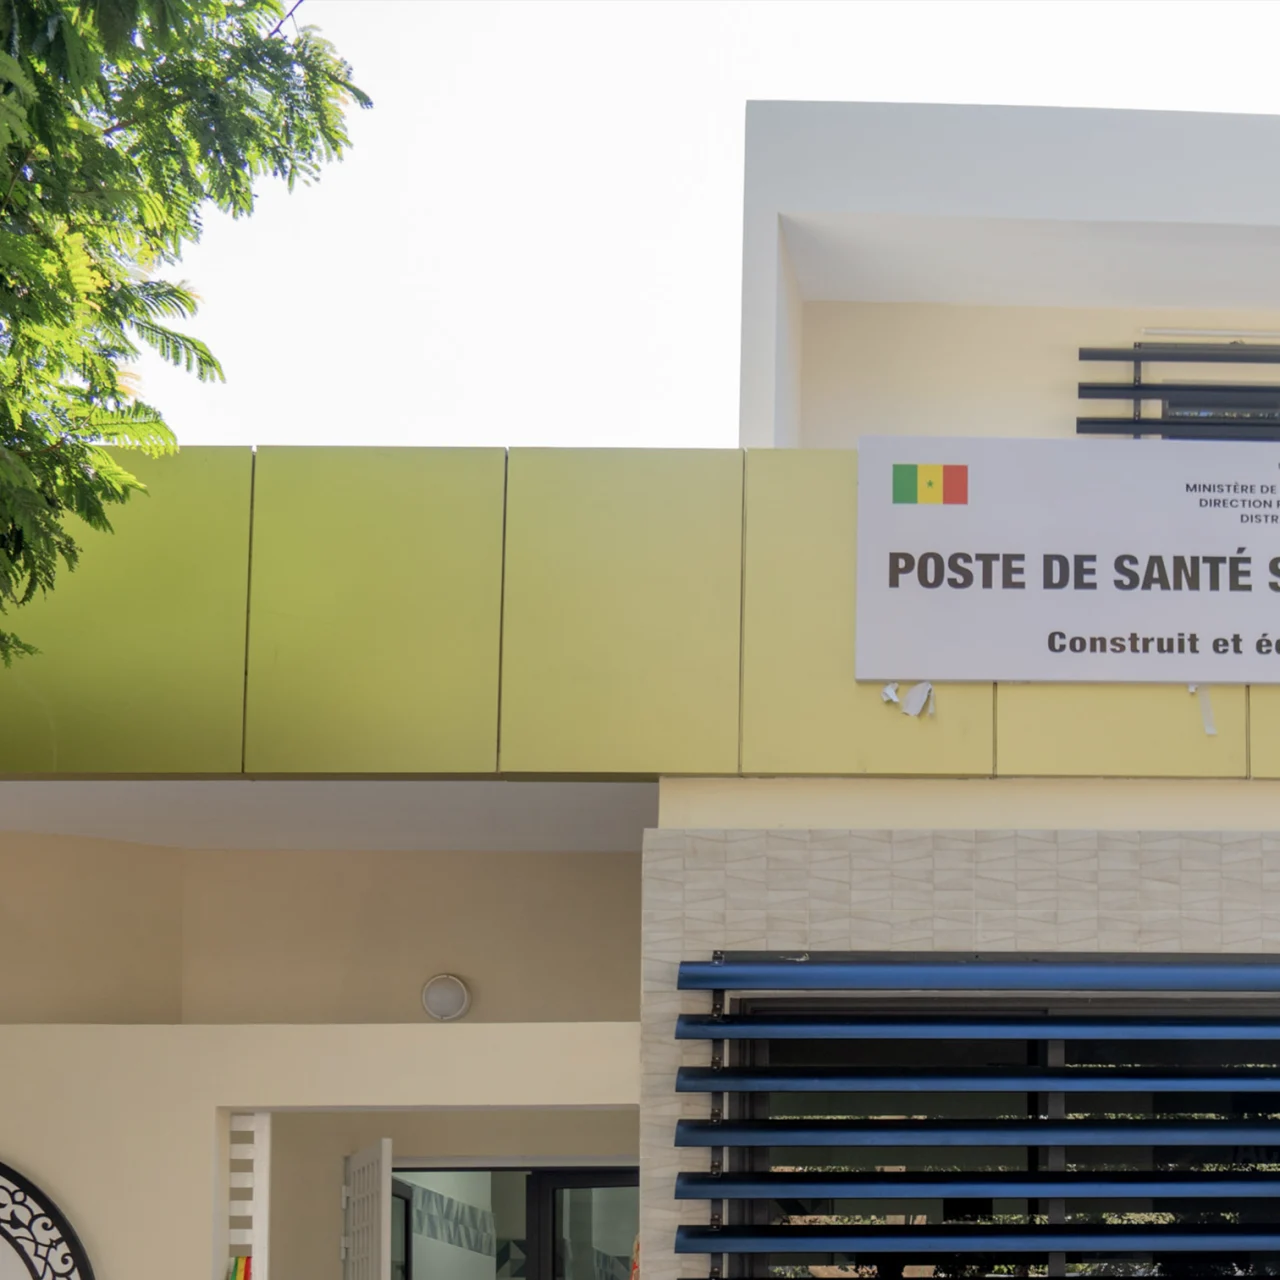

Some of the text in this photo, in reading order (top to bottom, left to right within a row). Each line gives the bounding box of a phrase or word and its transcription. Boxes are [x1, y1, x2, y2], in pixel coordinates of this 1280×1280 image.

[1185, 482, 1256, 494] MINISTÈRE
[1260, 485, 1276, 494] DE
[1199, 498, 1273, 509] DIRECTION
[888, 551, 1026, 590] POSTE
[1042, 553, 1098, 591] DE
[1113, 547, 1253, 593] SANTÉ
[1047, 631, 1200, 655] Construit
[1211, 633, 1243, 655] et
